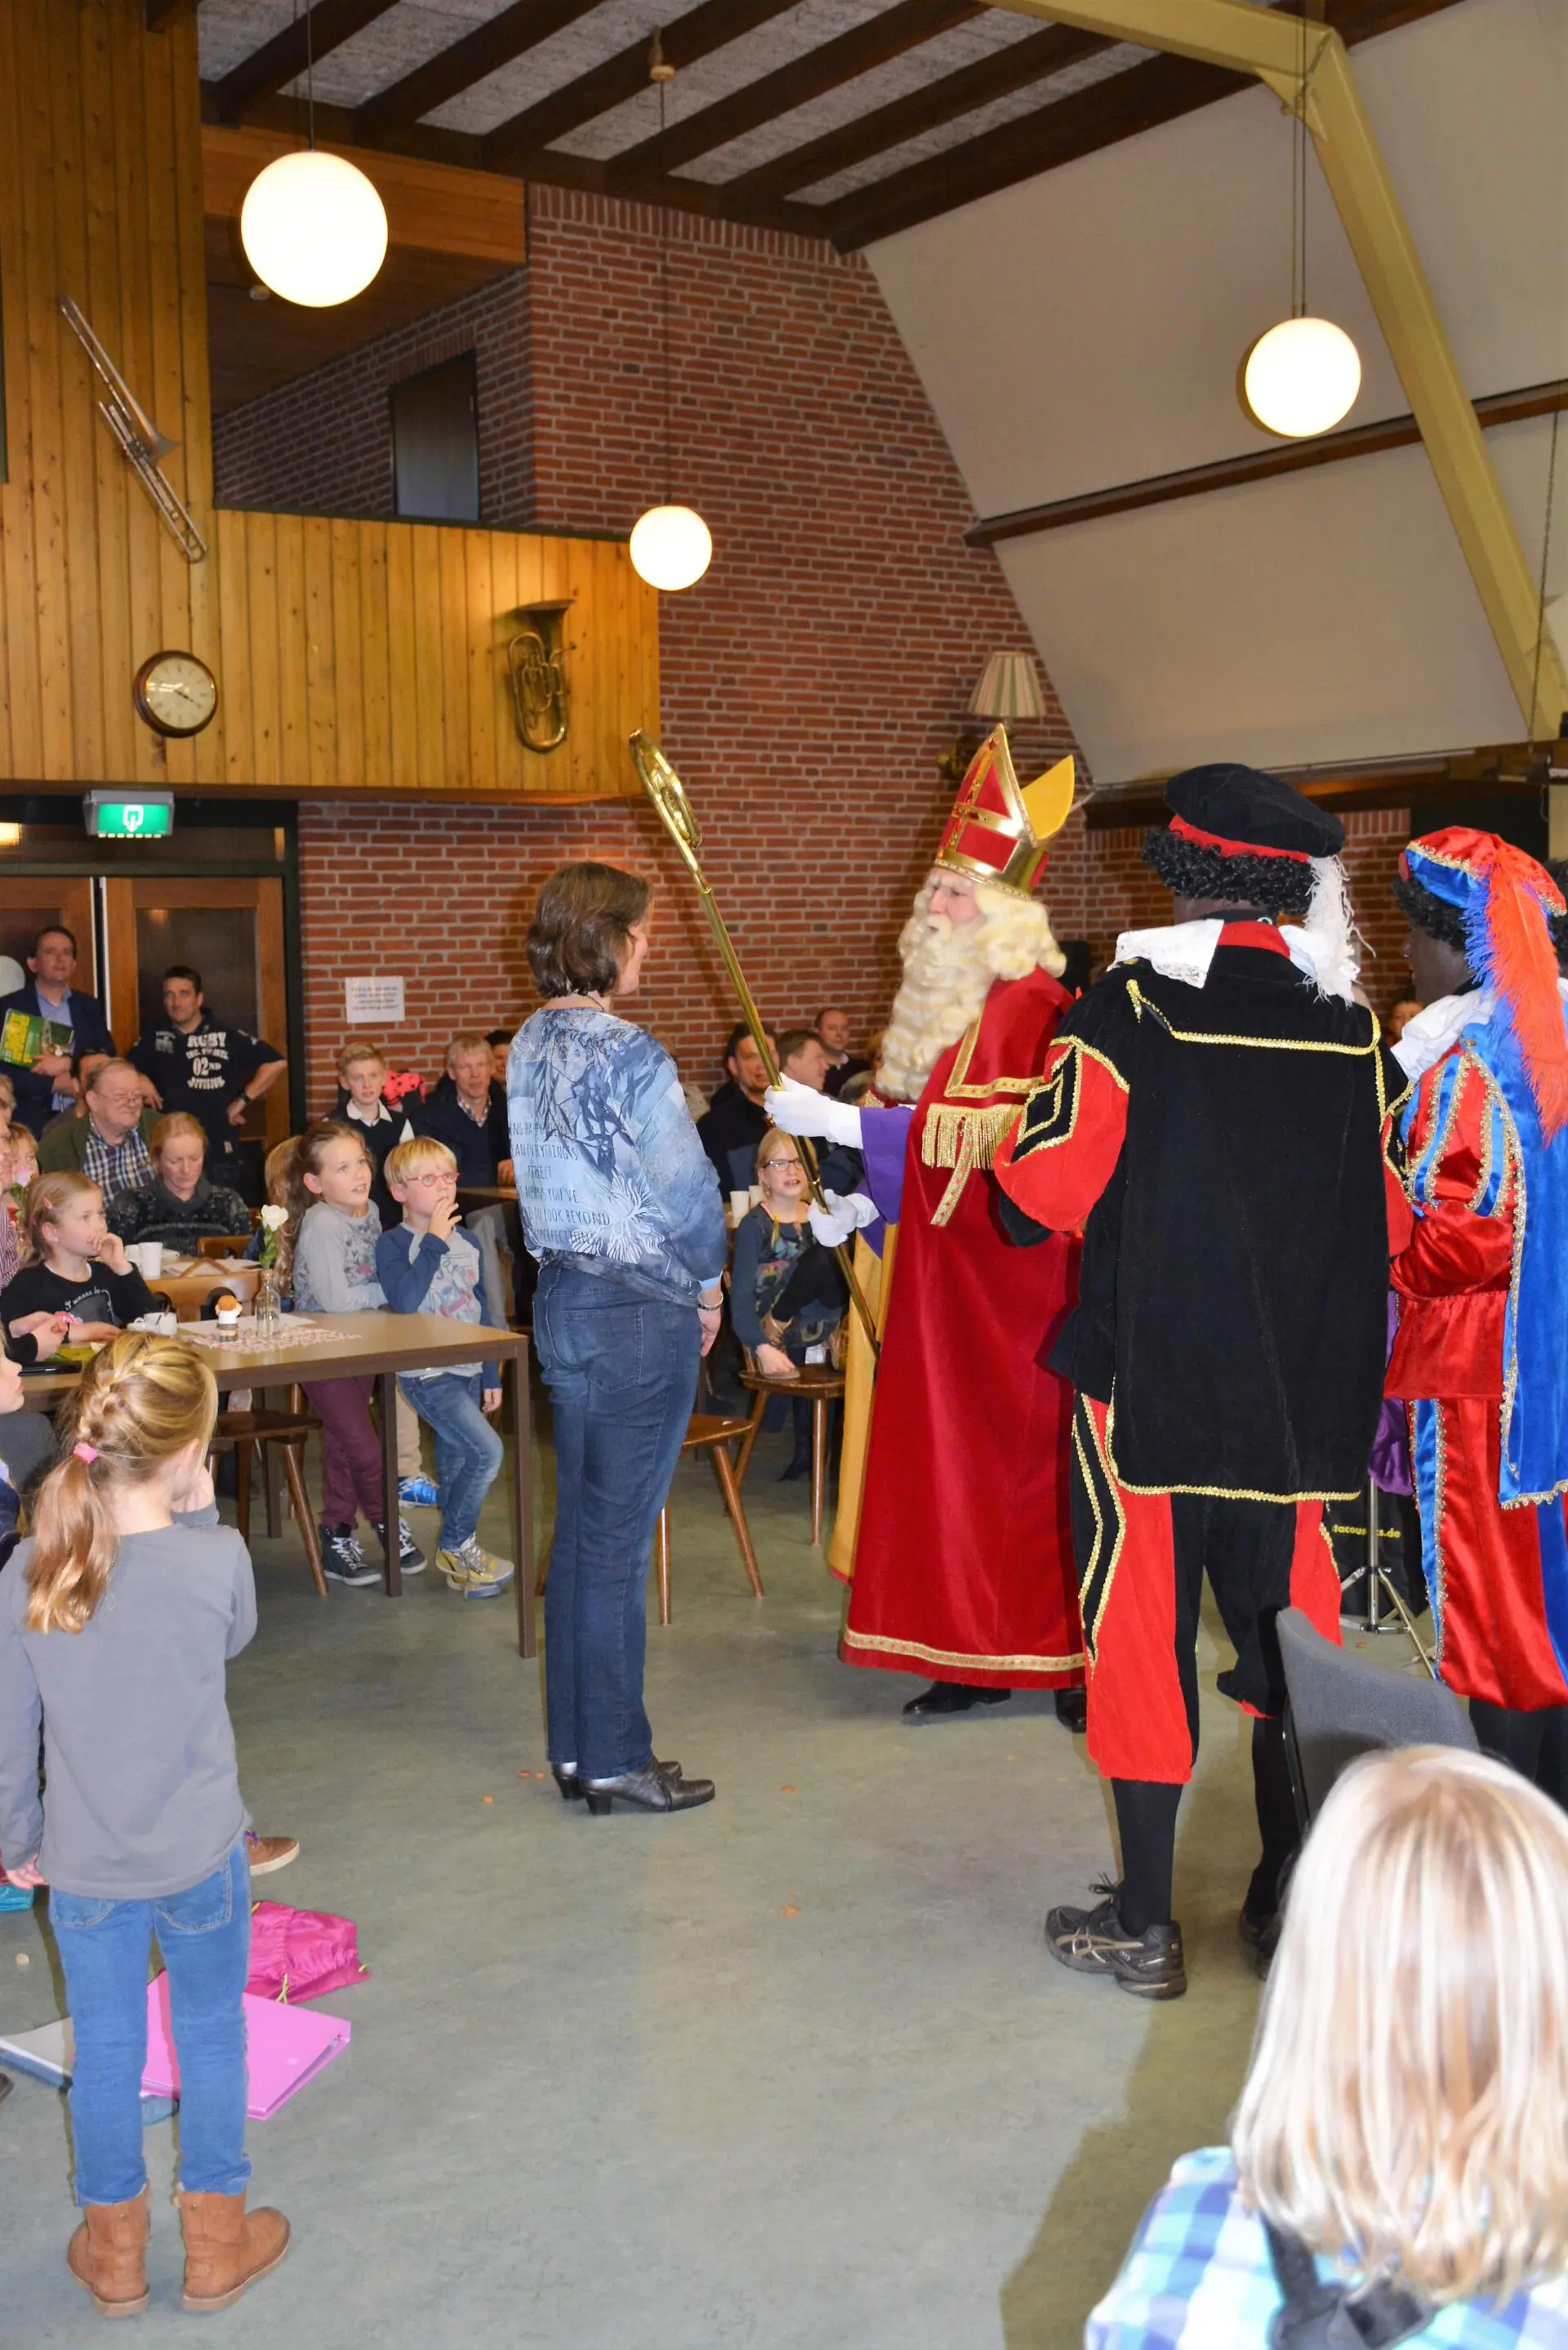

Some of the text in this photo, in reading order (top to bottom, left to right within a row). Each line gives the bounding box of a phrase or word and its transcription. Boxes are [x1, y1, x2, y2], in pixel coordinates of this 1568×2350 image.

[543, 1208, 564, 1222] LOOK
[565, 1209, 611, 1225] BEYOND
[1332, 1523, 1401, 1538] tacouss.de
